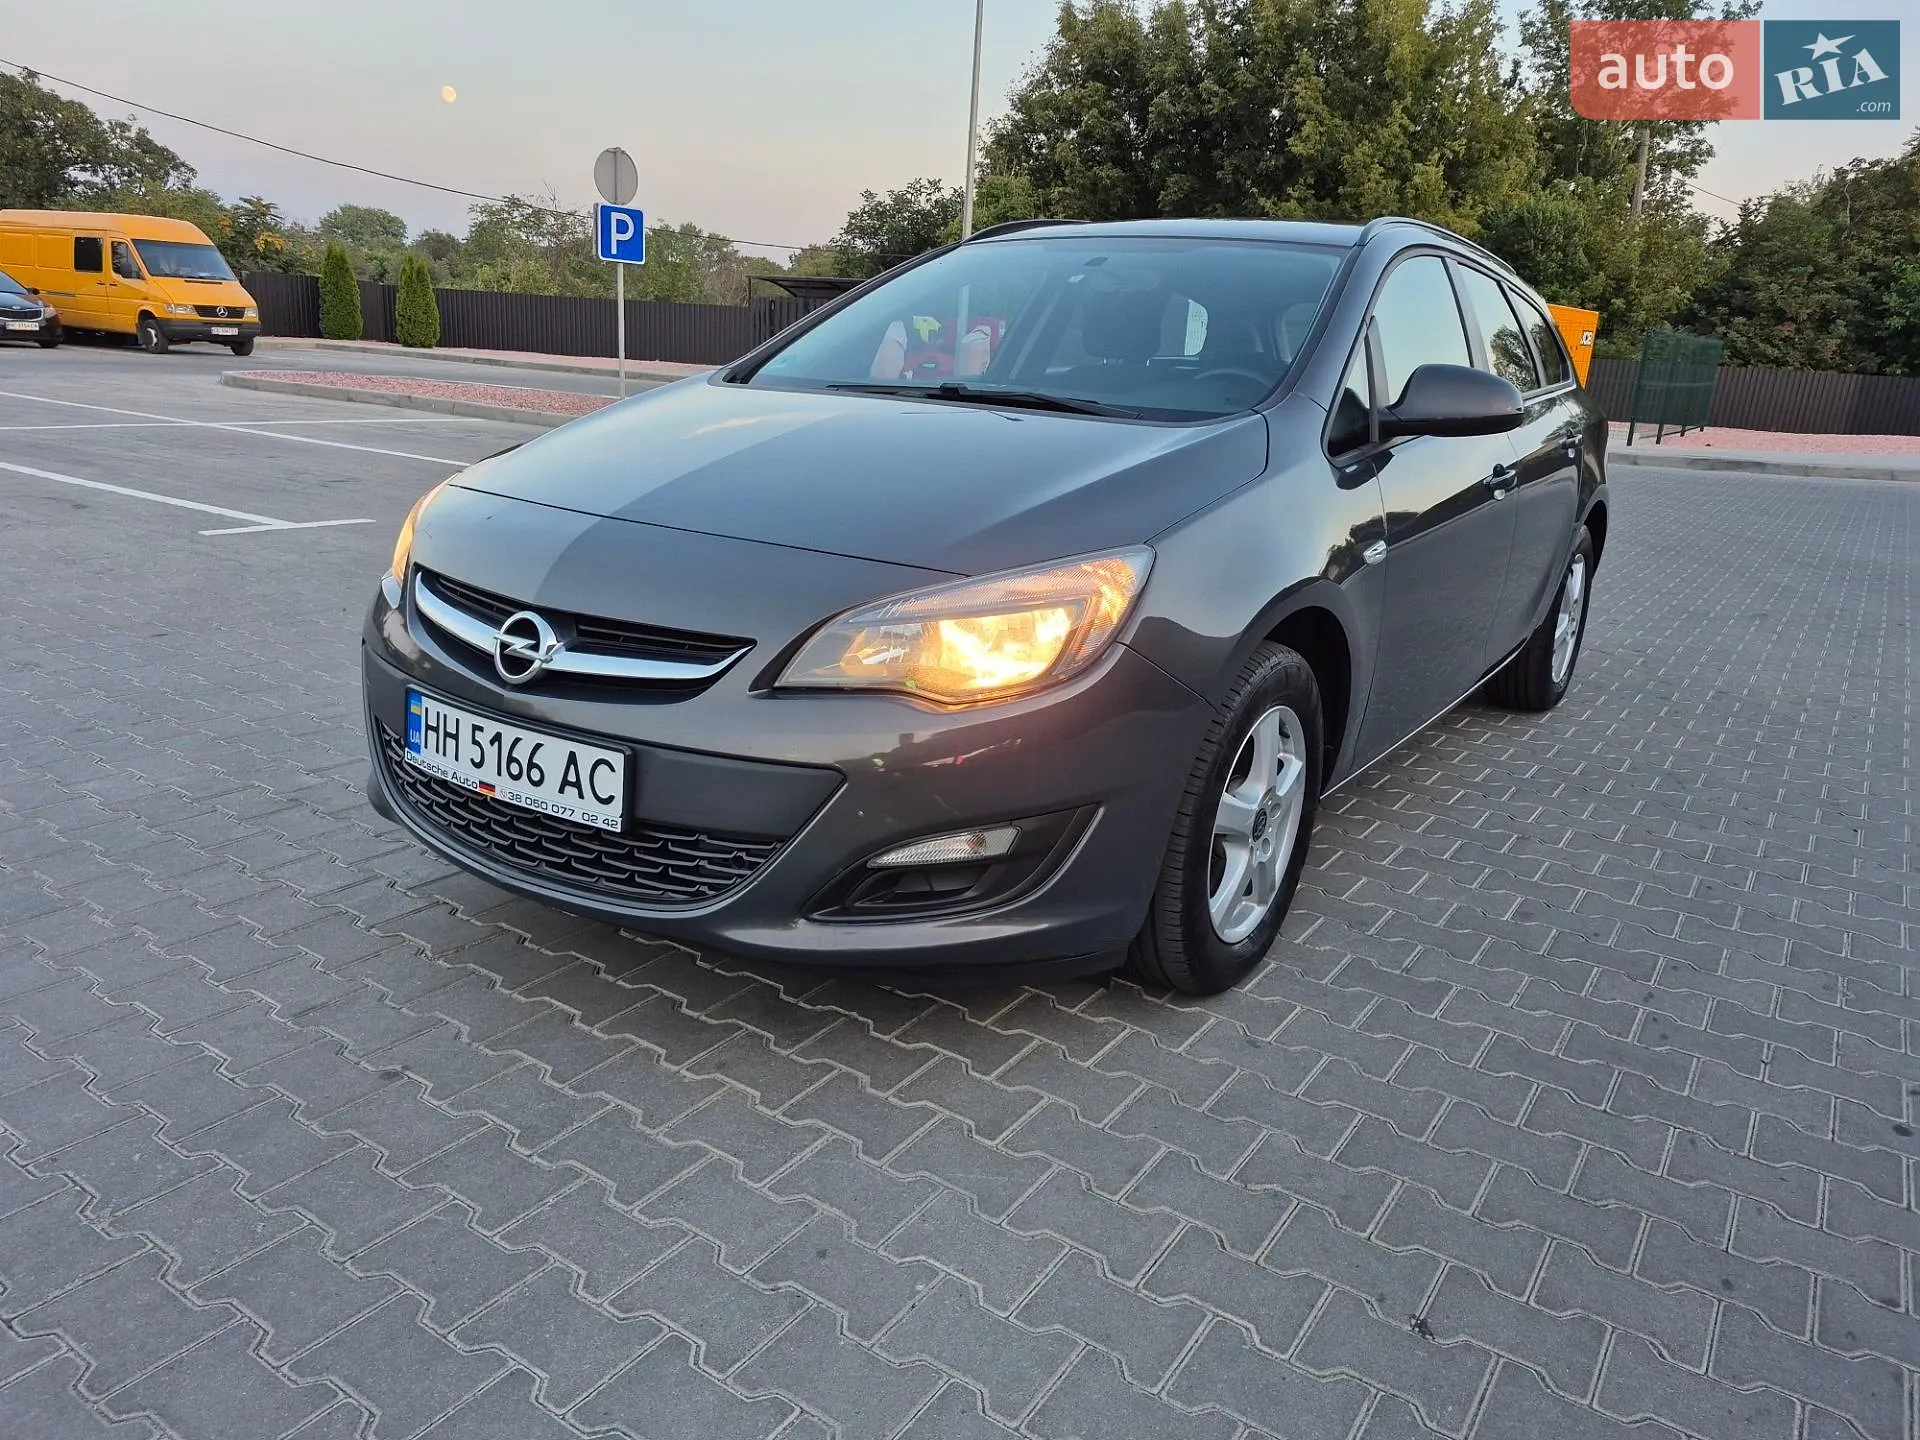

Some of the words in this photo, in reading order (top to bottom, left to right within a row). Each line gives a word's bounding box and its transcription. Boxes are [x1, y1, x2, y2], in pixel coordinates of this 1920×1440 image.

[611, 212, 634, 255] P
[410, 728, 421, 745] UA
[407, 751, 448, 777] Deutsche
[451, 771, 477, 789] Auto
[424, 707, 460, 762] HH
[470, 723, 545, 787] 5166
[558, 751, 616, 805] AC
[551, 804, 575, 817] 077
[582, 812, 598, 824] 02
[602, 818, 618, 829] 42
